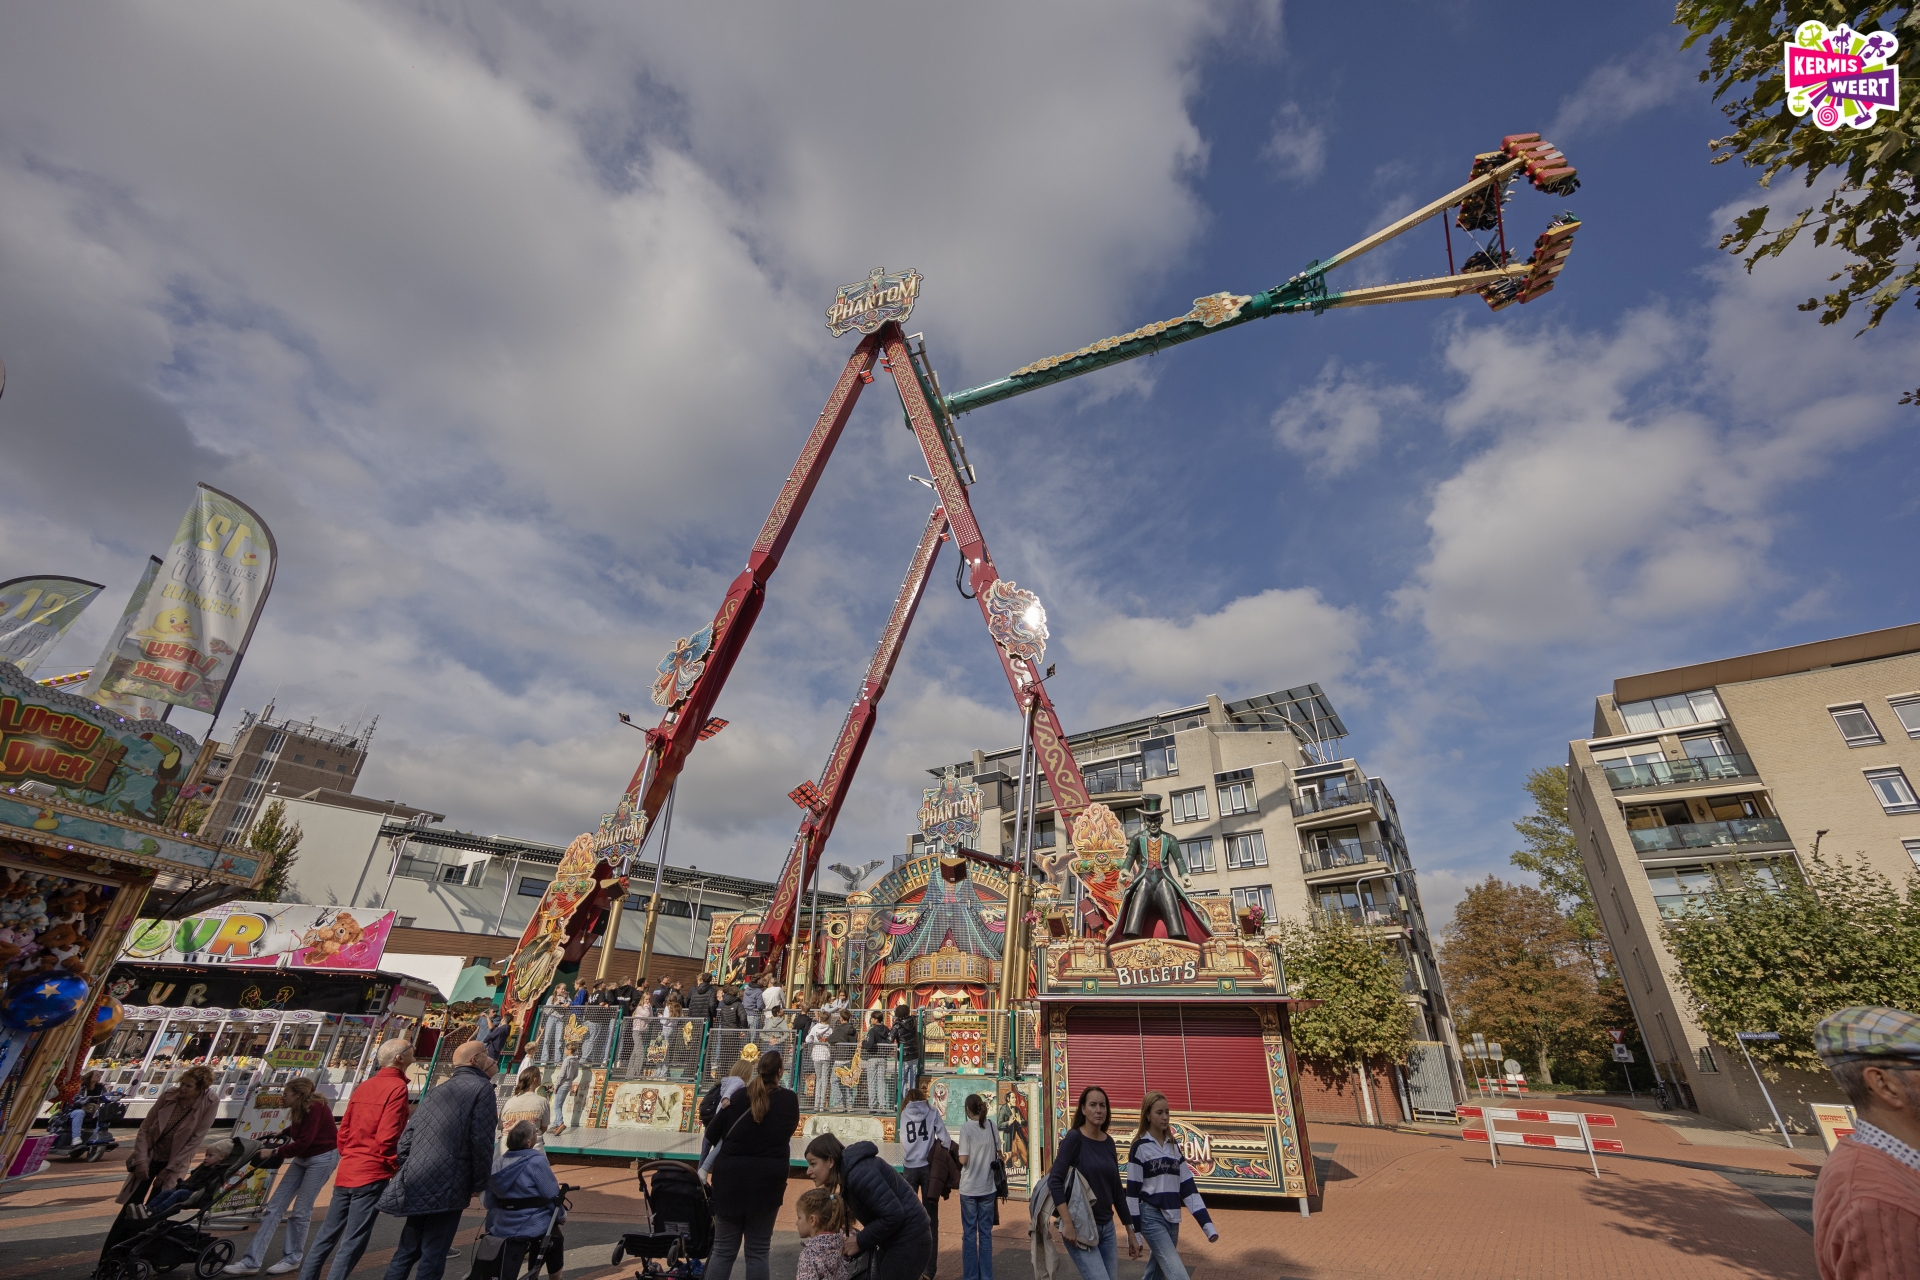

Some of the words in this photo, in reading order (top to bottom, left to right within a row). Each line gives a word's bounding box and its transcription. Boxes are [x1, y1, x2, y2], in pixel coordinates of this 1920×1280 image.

[826, 274, 922, 326] PHANTOM
[14, 588, 68, 626] 12
[2, 739, 95, 783] DUCK
[918, 789, 985, 830] PHANTOM
[594, 816, 648, 853] PHANTOM
[1116, 961, 1197, 986] BILLETS
[275, 1050, 302, 1060] LET
[303, 1052, 320, 1061] OP
[906, 1118, 928, 1143] 84
